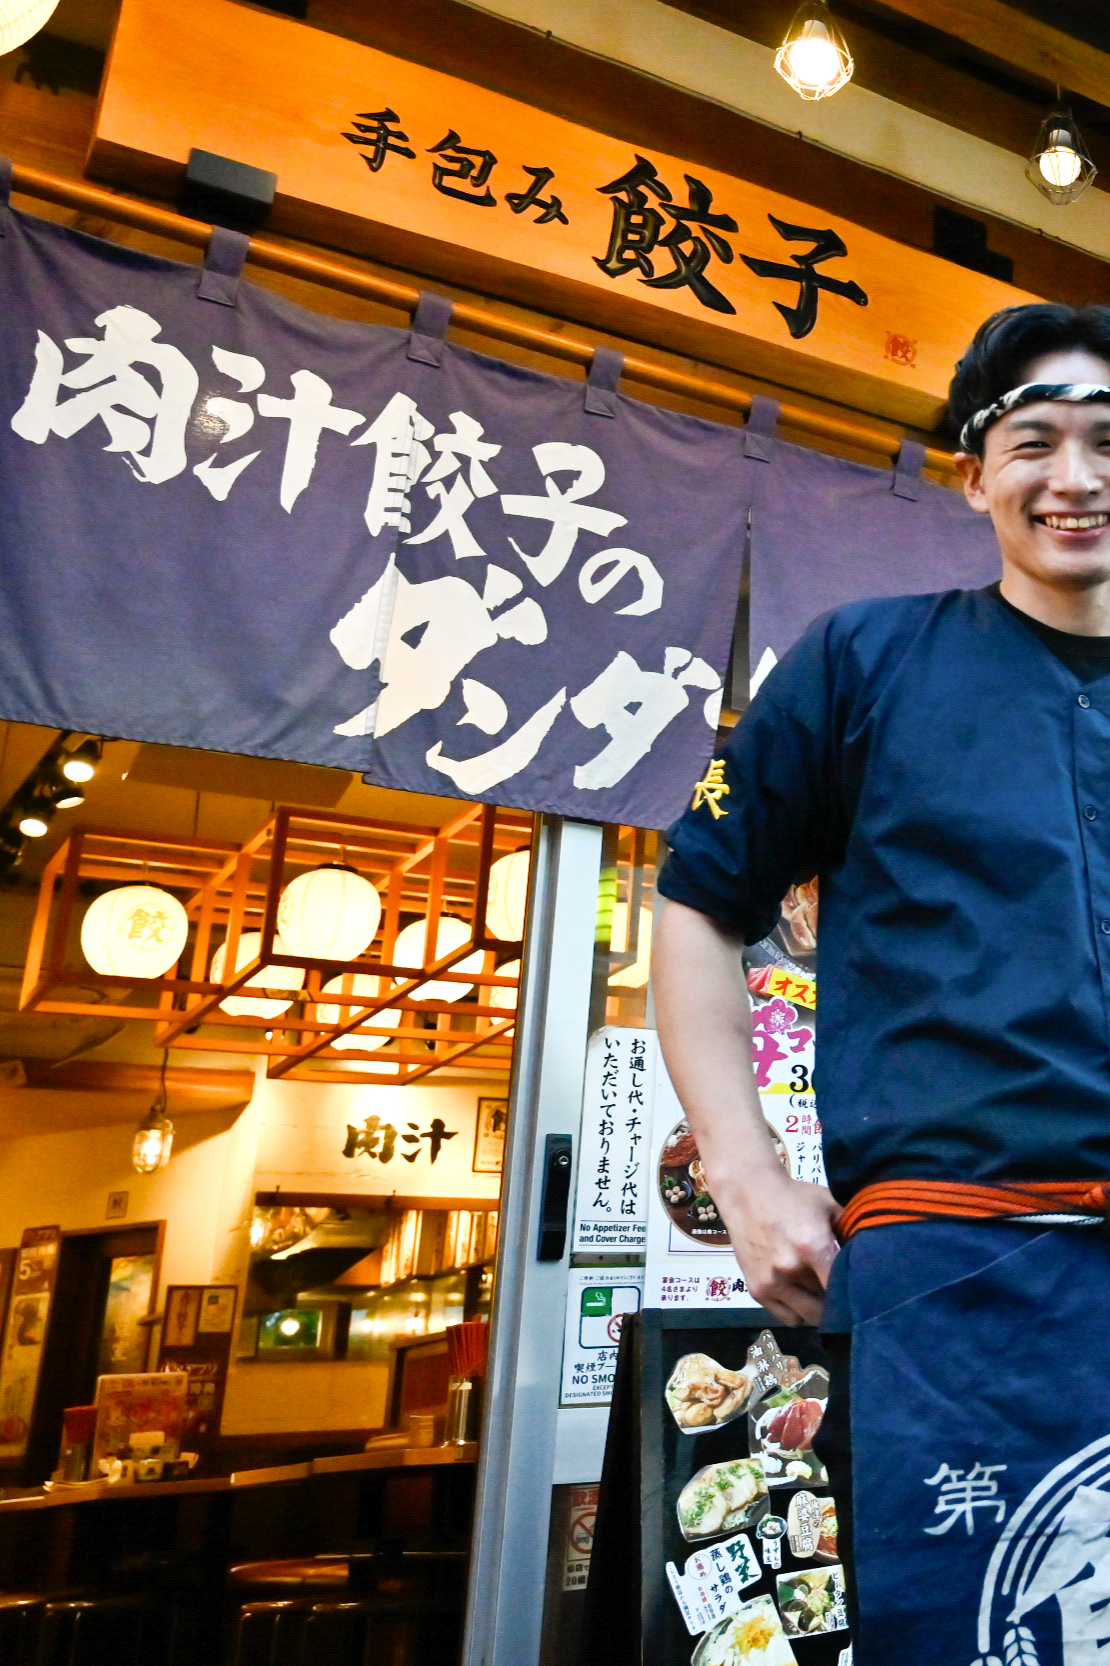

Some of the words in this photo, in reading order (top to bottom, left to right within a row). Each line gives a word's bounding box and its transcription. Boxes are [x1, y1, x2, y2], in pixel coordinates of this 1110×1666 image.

[341, 107, 869, 339] 手包み餃子
[11, 304, 664, 616] 肉汁餃子の
[691, 758, 731, 820] 長
[126, 907, 168, 944] 餃
[342, 1114, 459, 1166] 肉汁
[592, 1037, 621, 1213] いただいておりません。
[620, 1038, 647, 1215] お通し代・チャージ代は
[579, 1223, 591, 1232] No
[593, 1223, 631, 1234] Appetizer
[632, 1224, 646, 1233] Fee
[595, 1235, 617, 1243] Cover
[618, 1236, 646, 1244] Charge
[732, 1278, 749, 1293] 肉
[572, 1374, 589, 1385] NO
[923, 1462, 1008, 1536] 第
